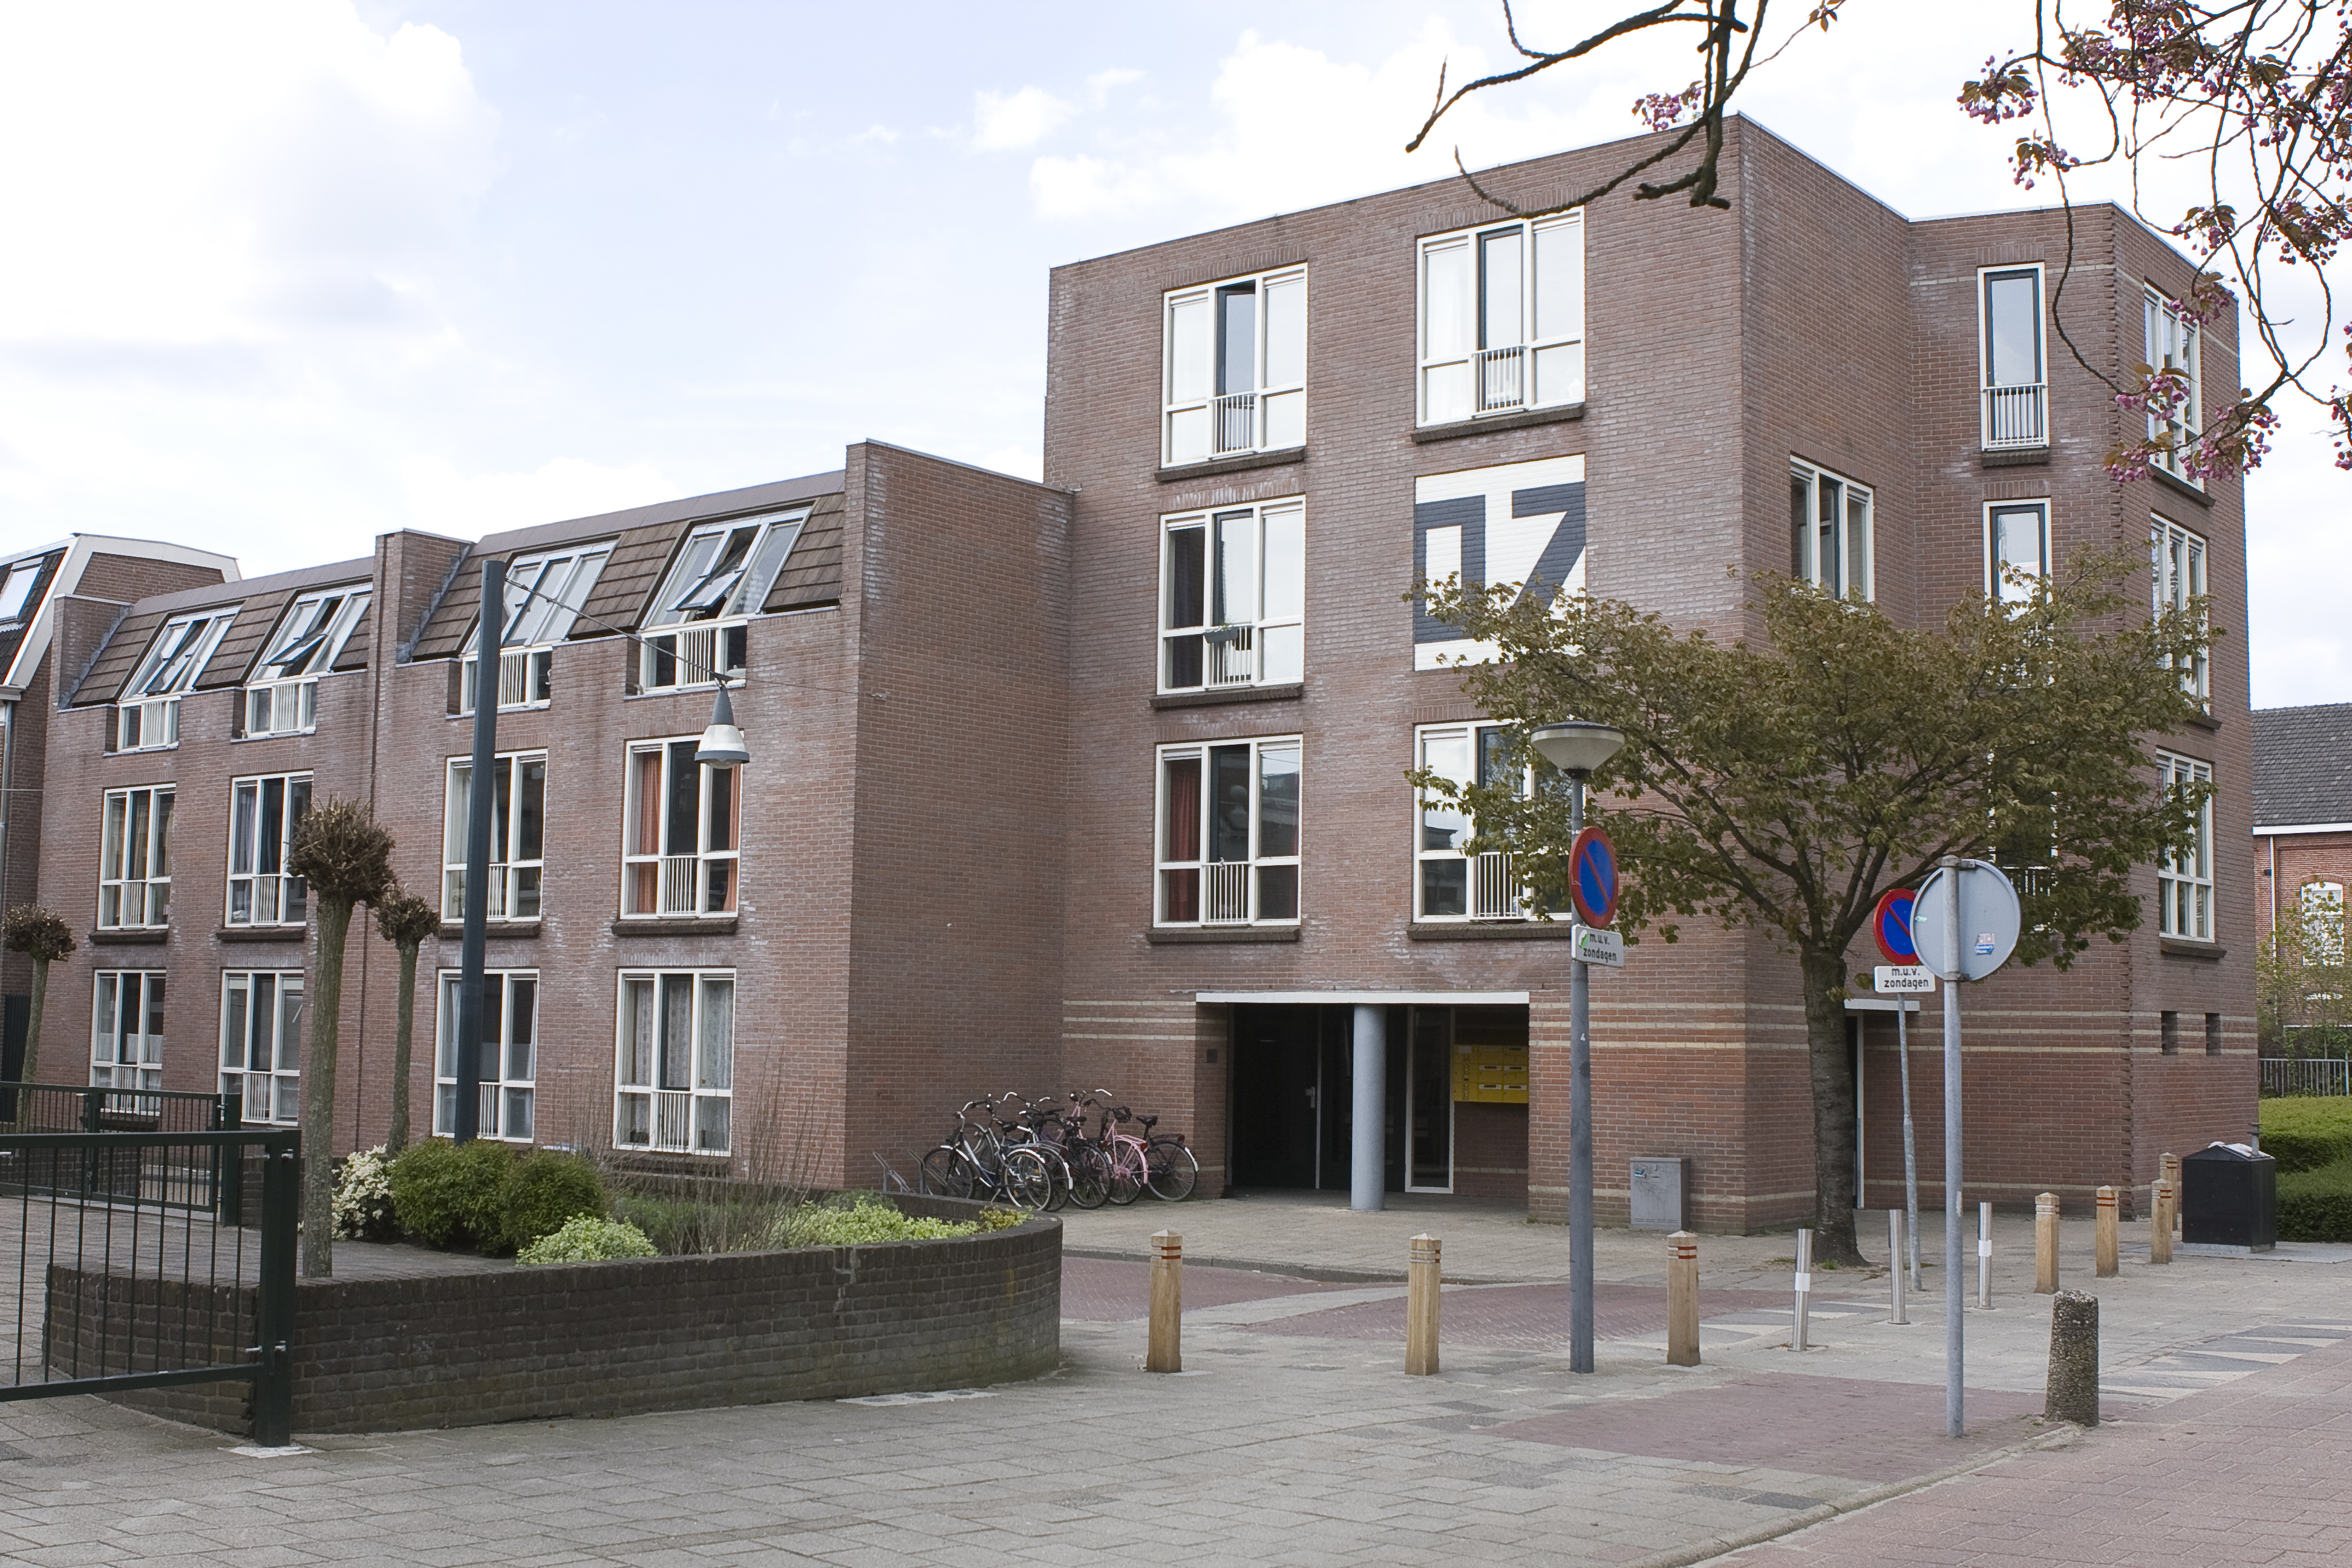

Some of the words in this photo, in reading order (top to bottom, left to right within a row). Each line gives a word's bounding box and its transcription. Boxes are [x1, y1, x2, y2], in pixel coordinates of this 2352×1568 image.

[1589, 933, 1610, 945] m.u.v.
[1583, 948, 1617, 963] zondagen
[1884, 978, 1929, 990] zondagen
